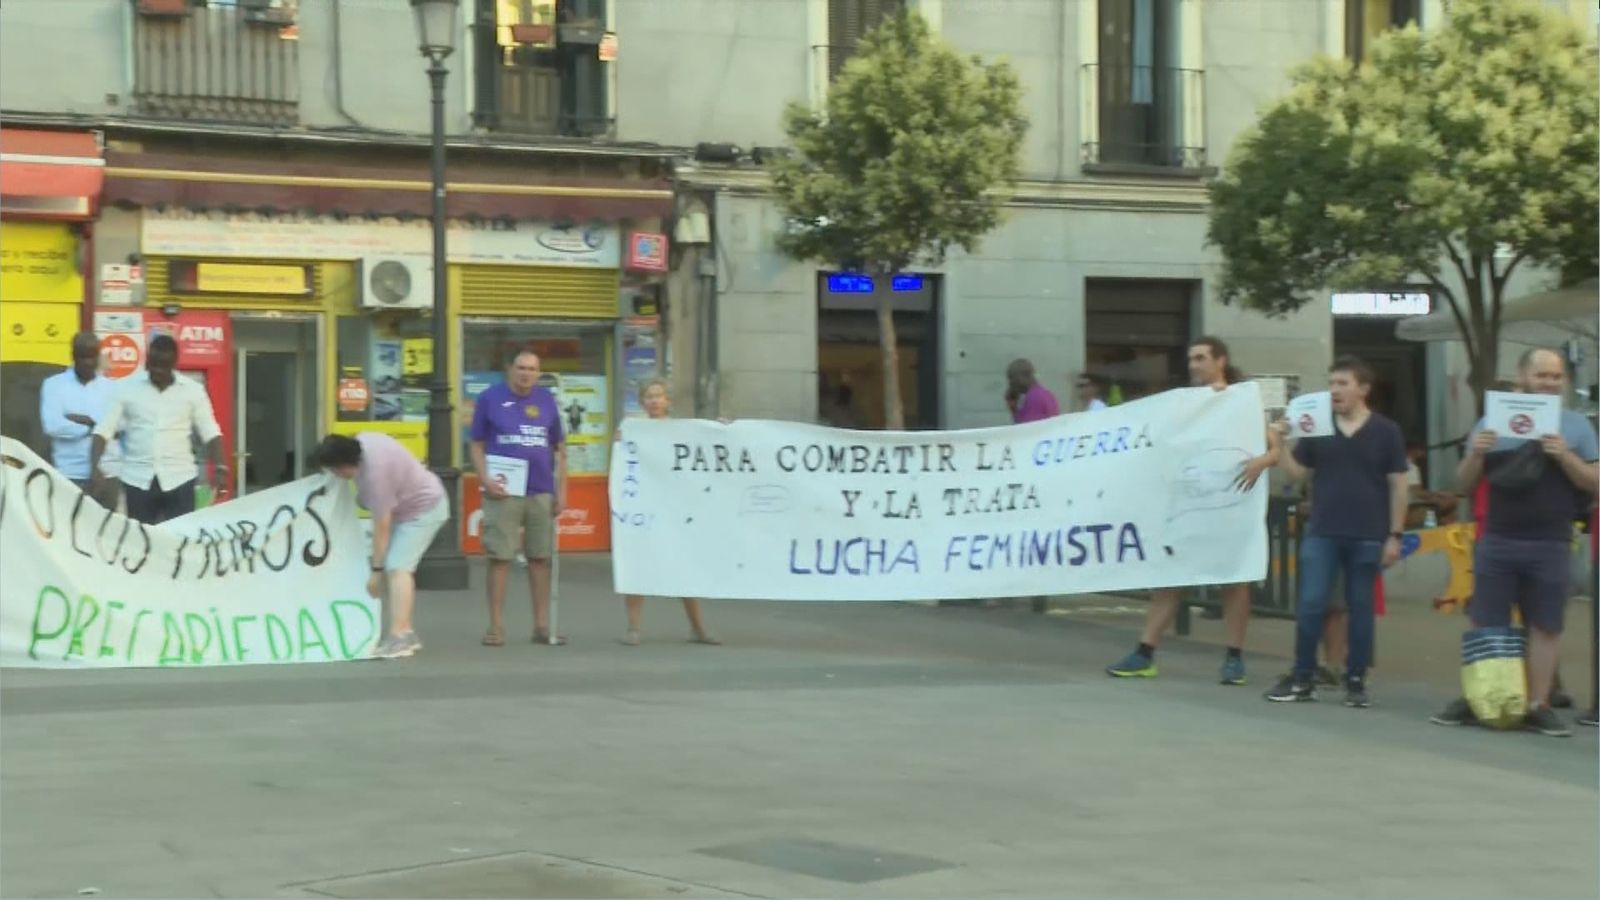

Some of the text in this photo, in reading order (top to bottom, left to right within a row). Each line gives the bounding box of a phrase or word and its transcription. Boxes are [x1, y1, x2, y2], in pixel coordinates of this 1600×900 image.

[180, 325, 224, 342] ATM
[672, 425, 1153, 474] PARA COMBATIR LA GUERRA
[841, 483, 1041, 519] Y LA TRATA
[789, 521, 1146, 575] LUCHA FEMINISTA
